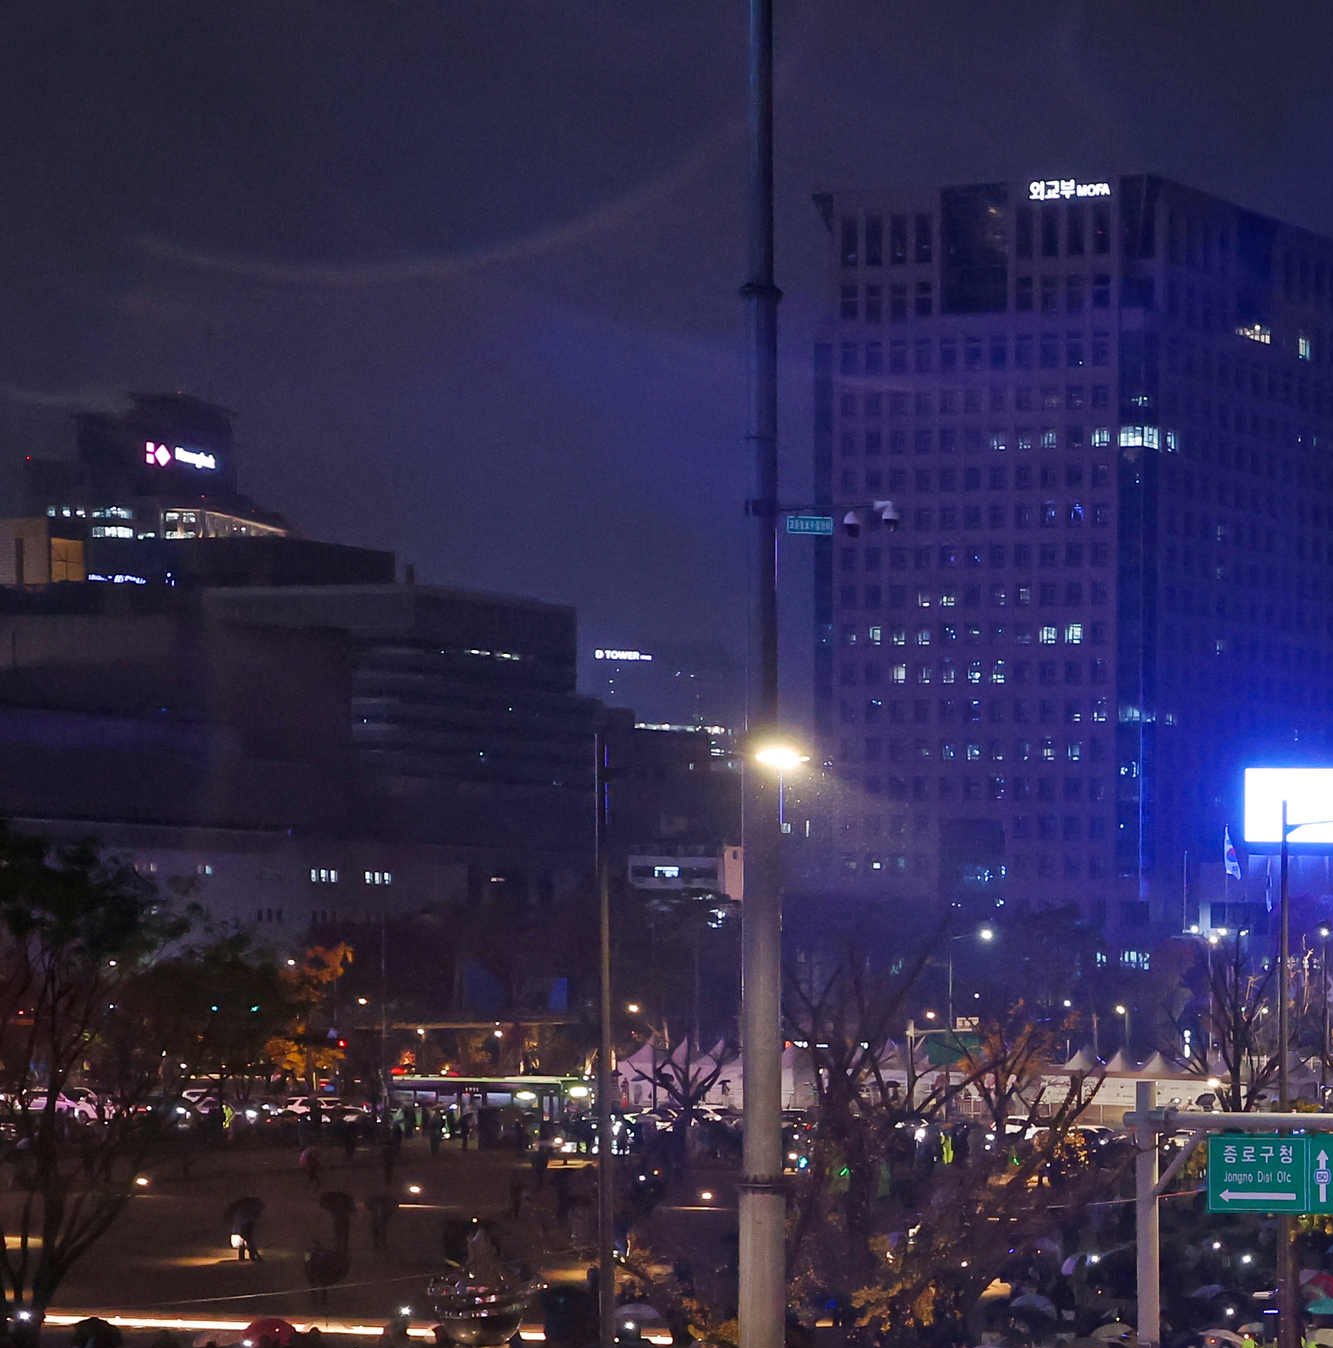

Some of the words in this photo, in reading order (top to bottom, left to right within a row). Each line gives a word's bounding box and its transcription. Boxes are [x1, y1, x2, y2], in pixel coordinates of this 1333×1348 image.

[1029, 179, 1075, 201] 외교부
[1076, 183, 1111, 198] MOFA
[595, 649, 604, 659] D
[605, 649, 640, 660] TOWER
[1223, 1145, 1294, 1164] 종로구청
[1224, 1171, 1253, 1185] Jongno
